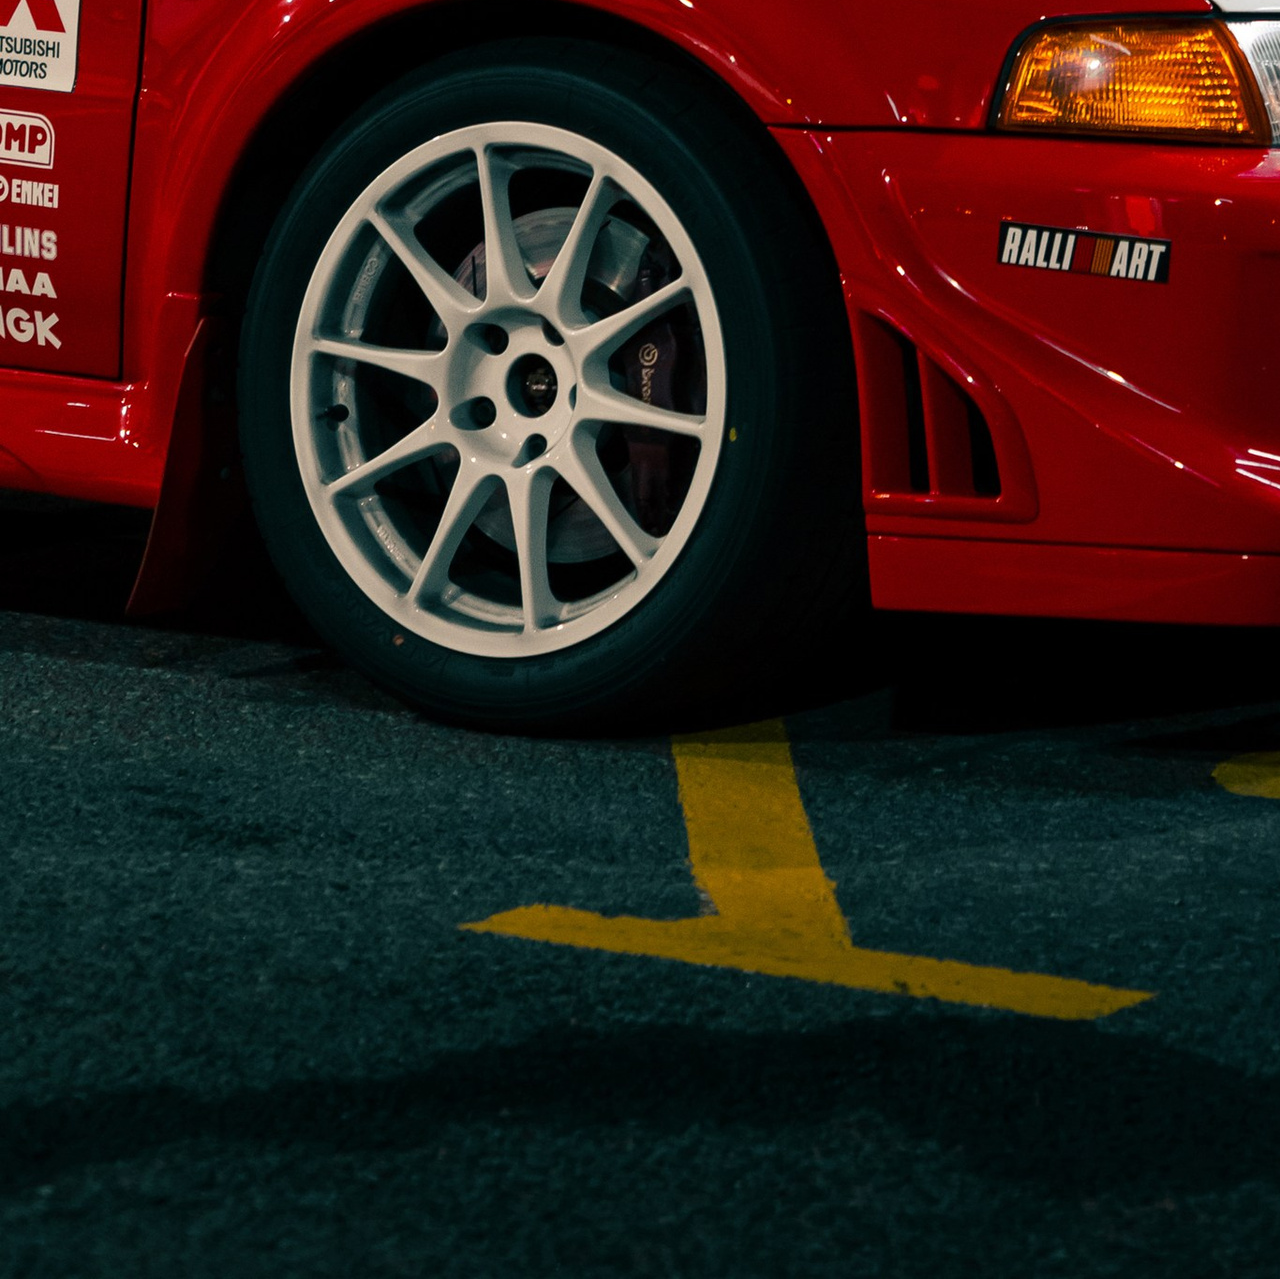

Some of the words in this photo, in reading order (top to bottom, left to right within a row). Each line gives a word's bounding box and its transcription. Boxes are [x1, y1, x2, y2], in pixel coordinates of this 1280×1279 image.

[0, 58, 48, 80] OTORS
[0, 121, 49, 154] MP
[11, 178, 60, 209] ENKEI
[0, 223, 58, 261] LINS
